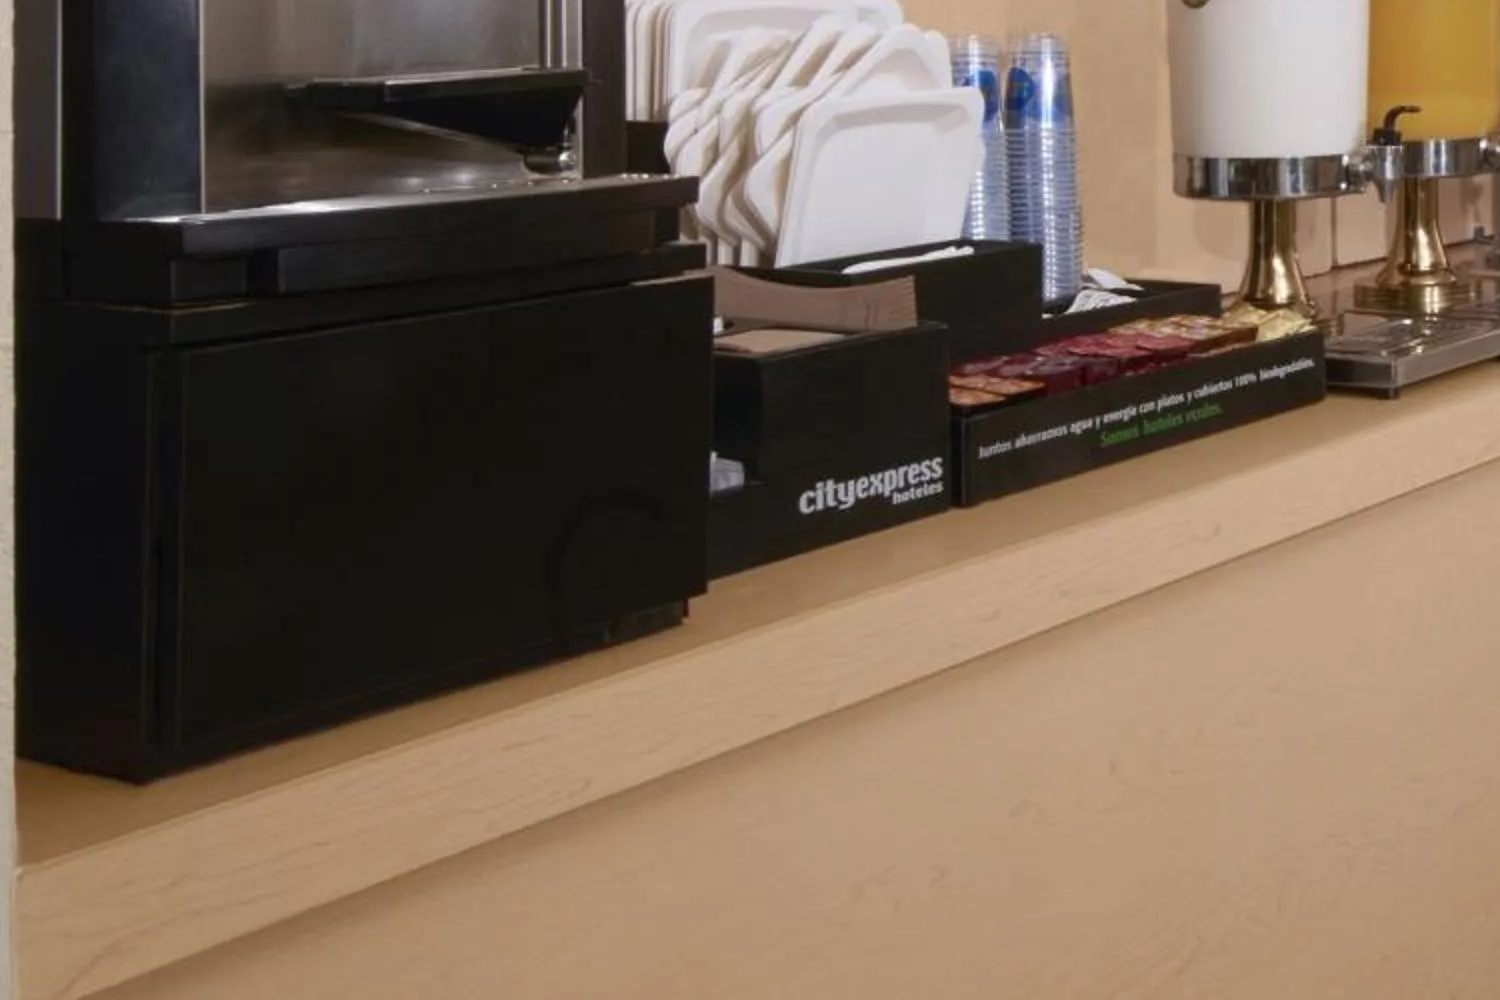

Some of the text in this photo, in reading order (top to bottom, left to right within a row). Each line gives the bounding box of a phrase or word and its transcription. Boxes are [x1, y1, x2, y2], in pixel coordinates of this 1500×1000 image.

[979, 440, 1012, 460] Juntos
[1014, 424, 1068, 449] ahorramos
[1070, 418, 1093, 435] agua
[1095, 416, 1101, 430] y
[1139, 401, 1155, 413] con
[1157, 393, 1184, 412] platos
[1194, 380, 1233, 399] cubiertos
[1101, 425, 1139, 446] Somos
[1143, 413, 1184, 434] hoteles
[892, 481, 944, 505] hoteles
